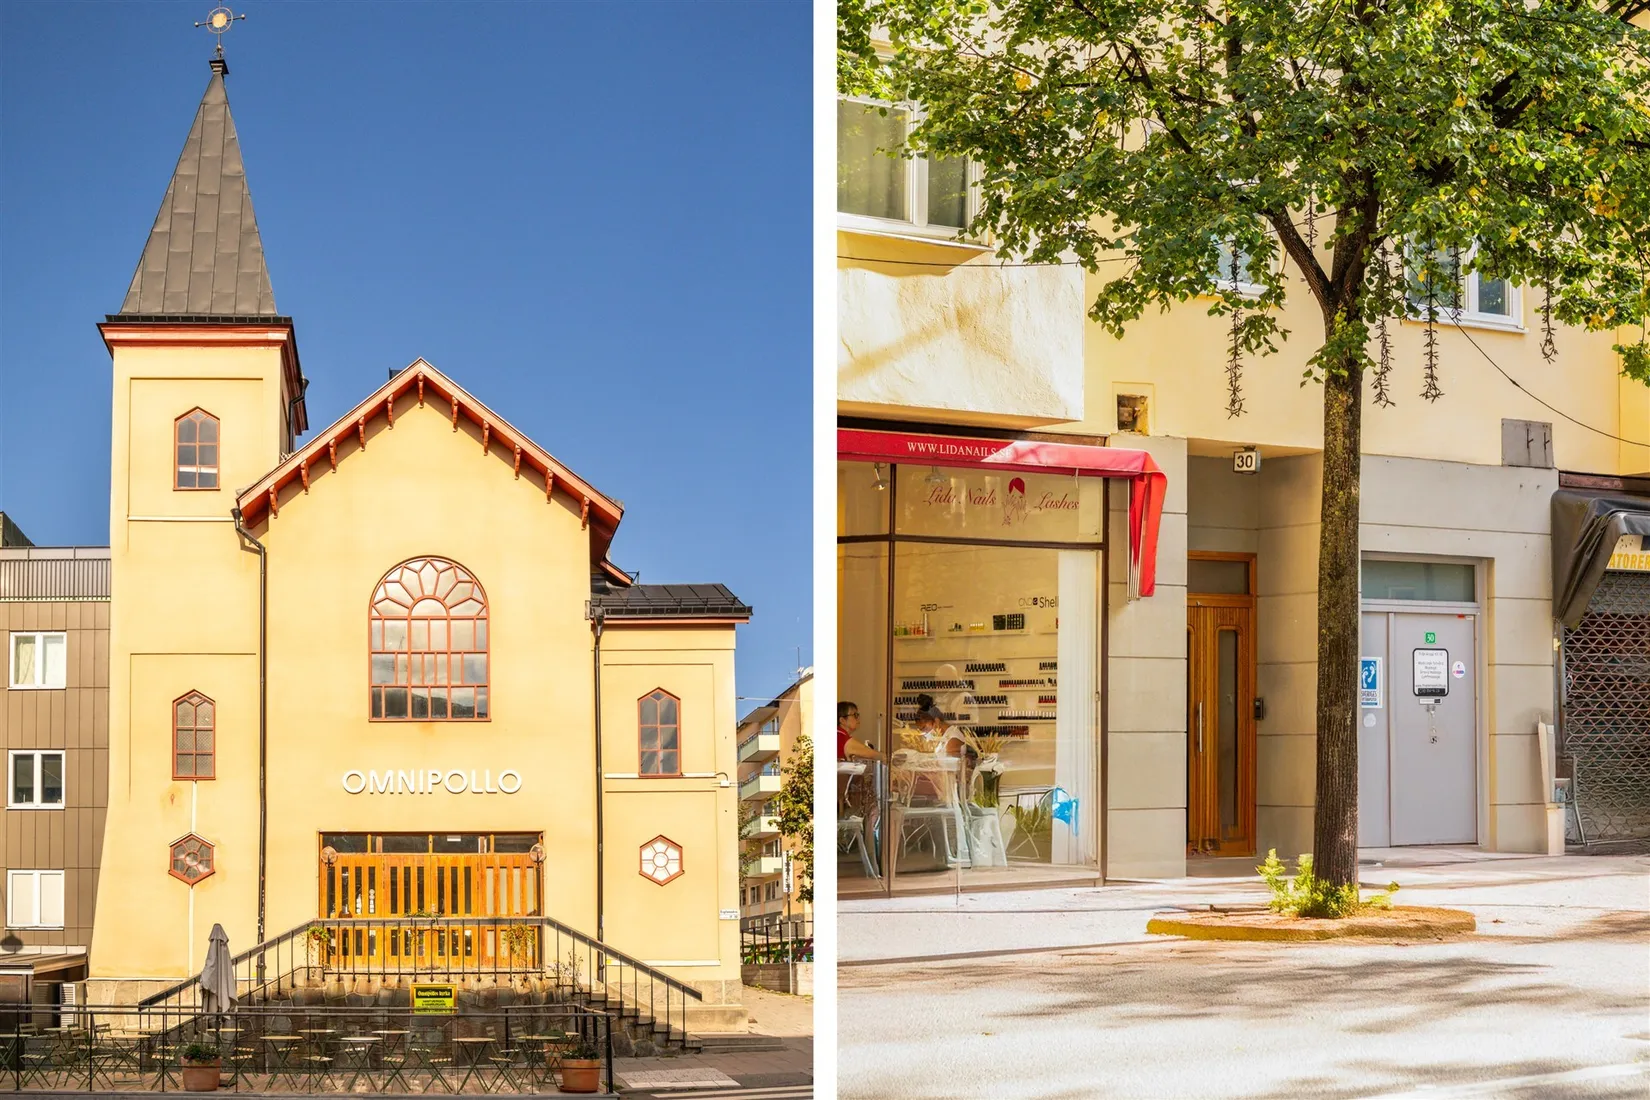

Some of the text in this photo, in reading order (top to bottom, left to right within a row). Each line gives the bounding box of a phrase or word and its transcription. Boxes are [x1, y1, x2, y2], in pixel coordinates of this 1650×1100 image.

[1236, 454, 1253, 468] 30
[958, 487, 996, 506] Nails
[1033, 491, 1080, 511] Lashes
[1427, 634, 1435, 643] 30
[342, 769, 523, 795] OMNIPOLLO
